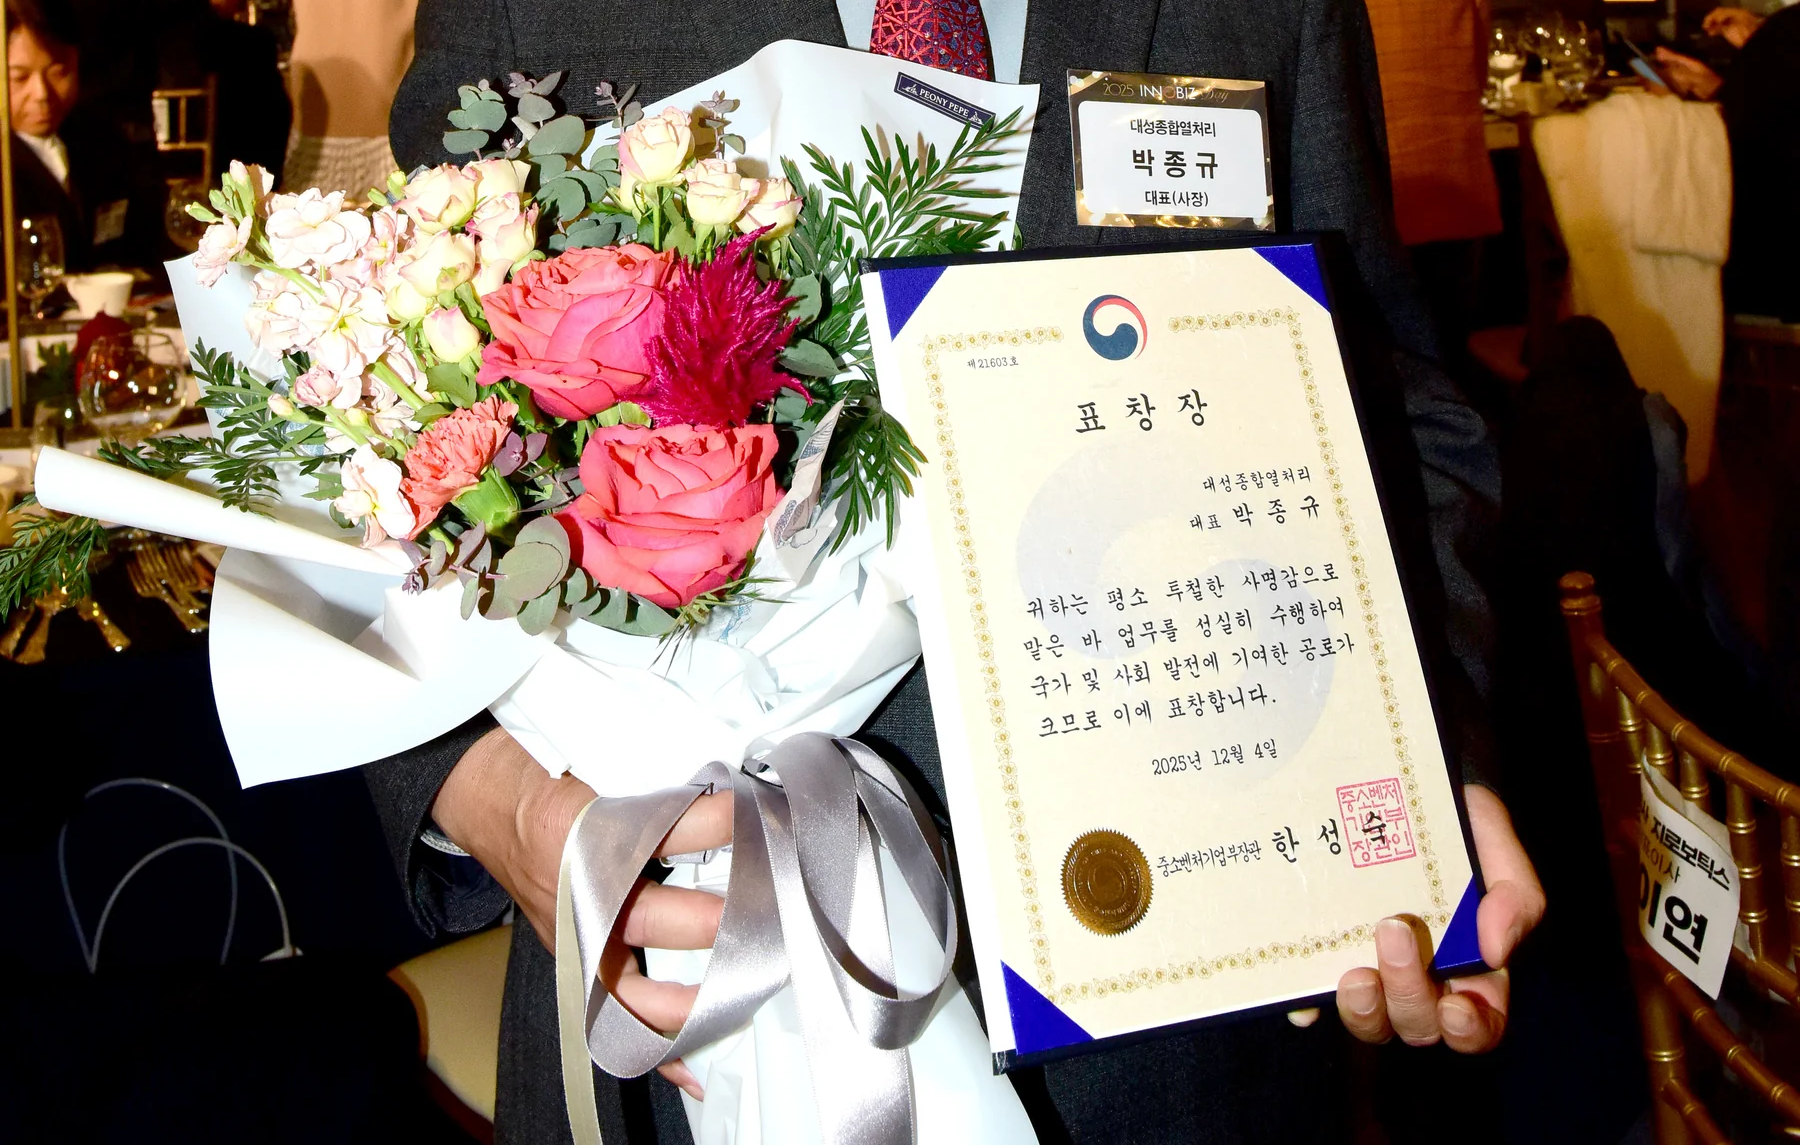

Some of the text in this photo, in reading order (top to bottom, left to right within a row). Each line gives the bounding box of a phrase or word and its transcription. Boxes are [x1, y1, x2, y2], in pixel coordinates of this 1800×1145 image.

[919, 88, 970, 117] PEONY PEPE
[1102, 83, 1134, 97] 2025
[1139, 84, 1197, 100] INNOBIZ
[1130, 119, 1217, 137] 대성종합열처리
[1145, 190, 1209, 207] 대표(사장)
[1202, 465, 1311, 493] 대성종합열처리
[1189, 514, 1222, 533] 대표
[1026, 563, 1339, 619] 귀하는 평소 투철한 사명감으로
[1023, 596, 1344, 661] 맡은 바 업무를 성실히 수행하여
[1030, 633, 1355, 698] 국가 및 사회 발전에 기여한 공로가
[1039, 683, 1276, 738] 크므로 이에 표창합니다.
[1151, 738, 1278, 776] 2025년 12월 4일
